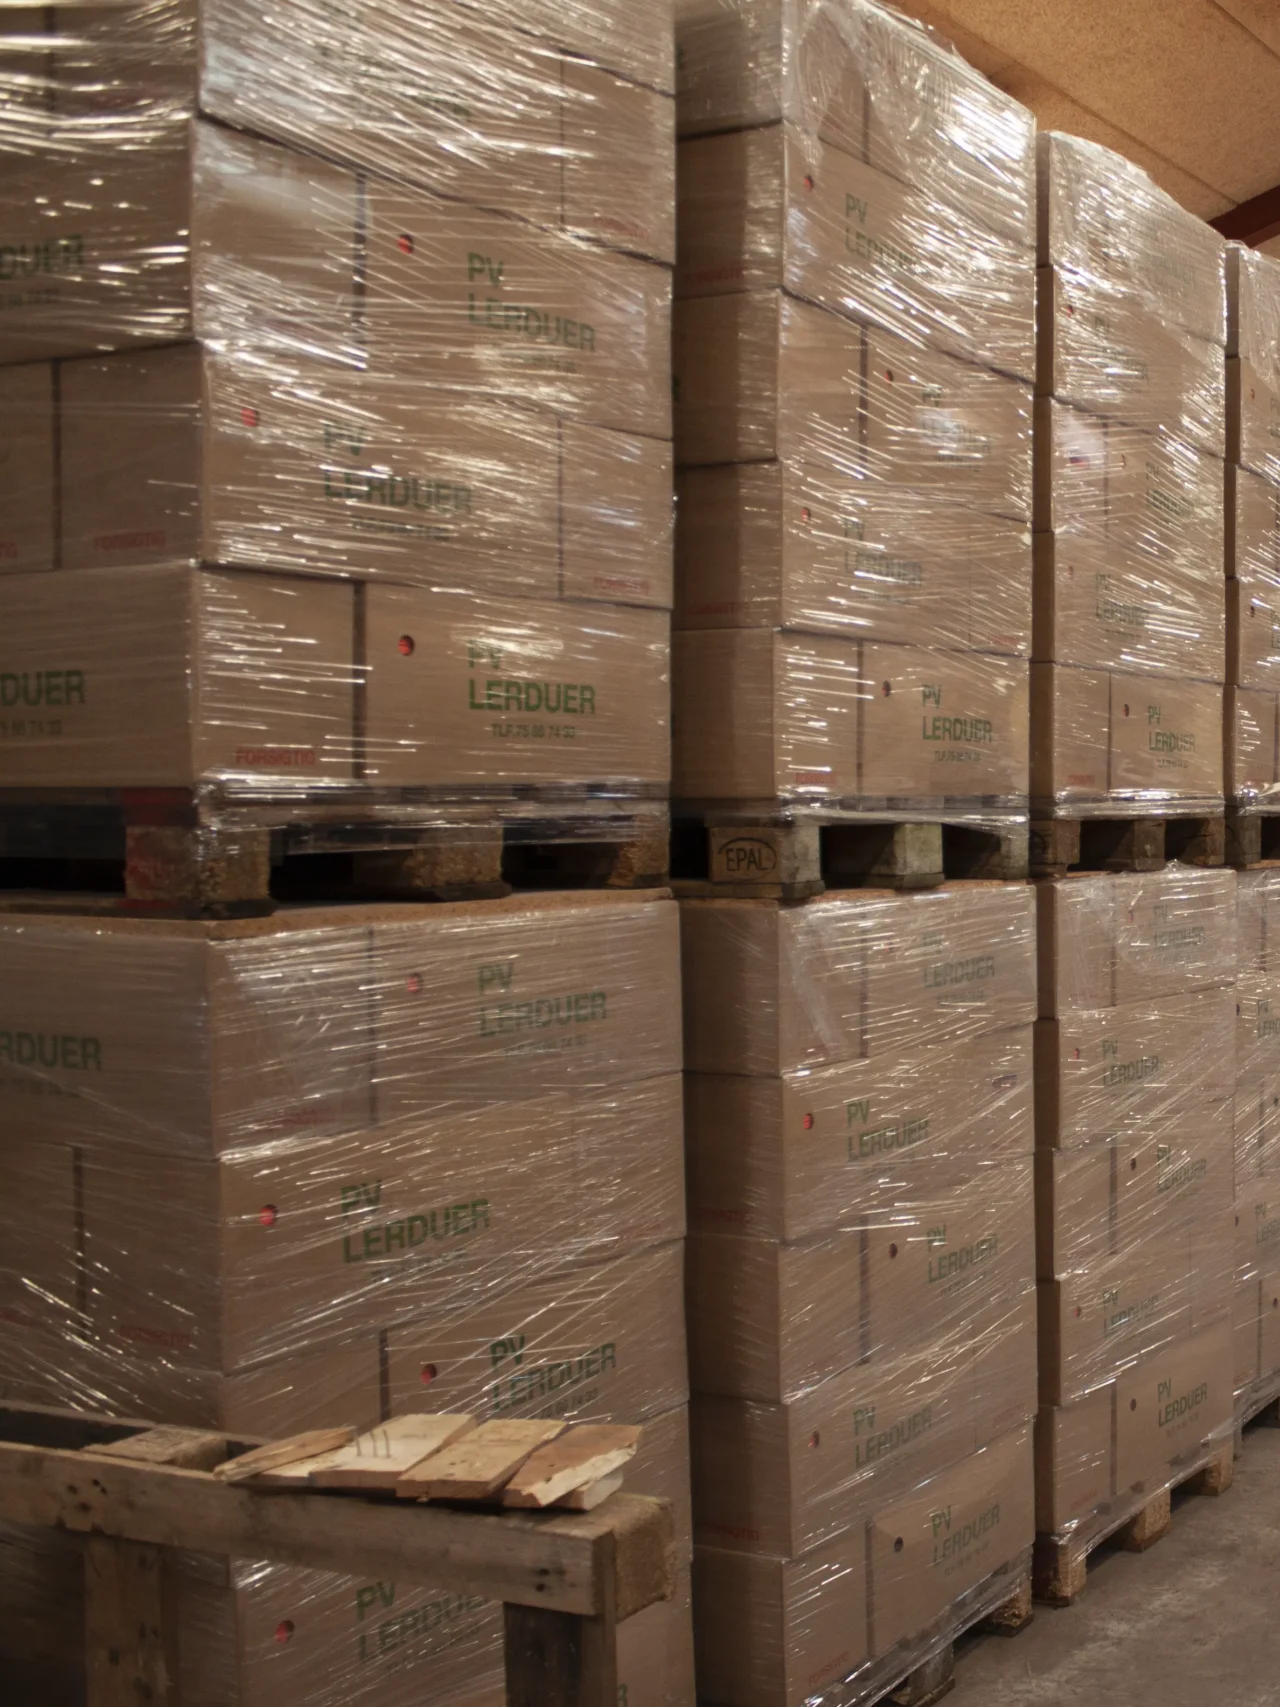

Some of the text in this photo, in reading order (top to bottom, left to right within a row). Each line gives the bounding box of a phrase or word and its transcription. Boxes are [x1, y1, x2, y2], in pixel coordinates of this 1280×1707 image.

[845, 192, 868, 224] PV
[467, 251, 503, 285] PV
[468, 292, 596, 353] LERDUER
[468, 679, 596, 715] LERDUER
[921, 683, 943, 708] PV
[922, 715, 993, 743] LERDUER
[1147, 705, 1161, 725] PV
[236, 748, 316, 766] FORSIGTIG
[1149, 731, 1196, 752] LERDUER
[726, 848, 769, 871] EPAL
[477, 962, 514, 996] PV
[477, 991, 607, 1037] LERDUER
[1102, 1039, 1118, 1060] PV
[847, 1099, 870, 1128] PV
[847, 1117, 929, 1163] LERDUER
[341, 1180, 382, 1220] PV
[343, 1198, 491, 1263] LERDUER
[490, 1333, 525, 1367] PV
[493, 1342, 616, 1410] LERDUER
[1157, 1377, 1172, 1403] PV
[853, 1400, 877, 1436] PV
[1158, 1382, 1208, 1429] LERDUER
[855, 1403, 932, 1469] LERDUER
[931, 1504, 952, 1538] PV
[932, 1503, 1000, 1567] LERDUER
[356, 1581, 396, 1621] PV
